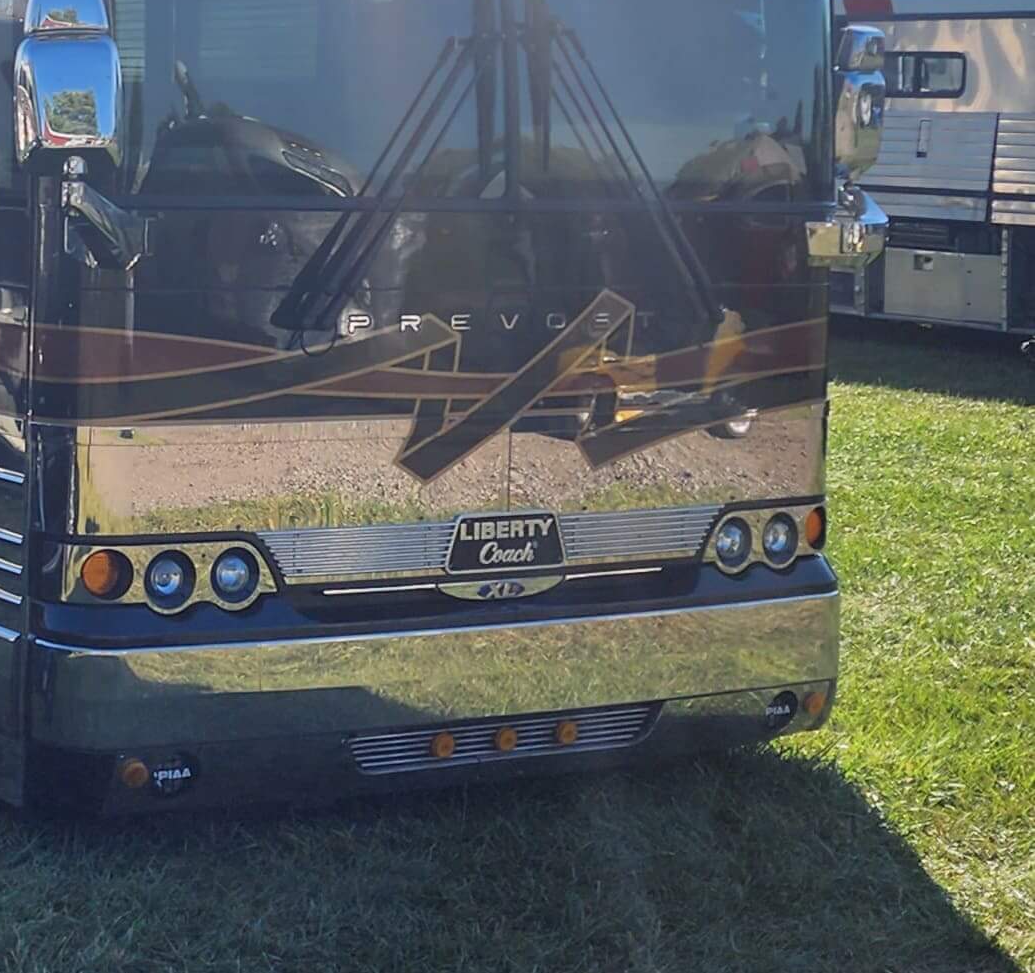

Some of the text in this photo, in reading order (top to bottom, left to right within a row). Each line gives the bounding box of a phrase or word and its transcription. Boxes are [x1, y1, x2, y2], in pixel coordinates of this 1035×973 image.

[348, 312, 654, 335] PREVOST
[459, 518, 553, 541] LIBERTY
[479, 541, 535, 565] Coach
[157, 767, 191, 781] PIAA
